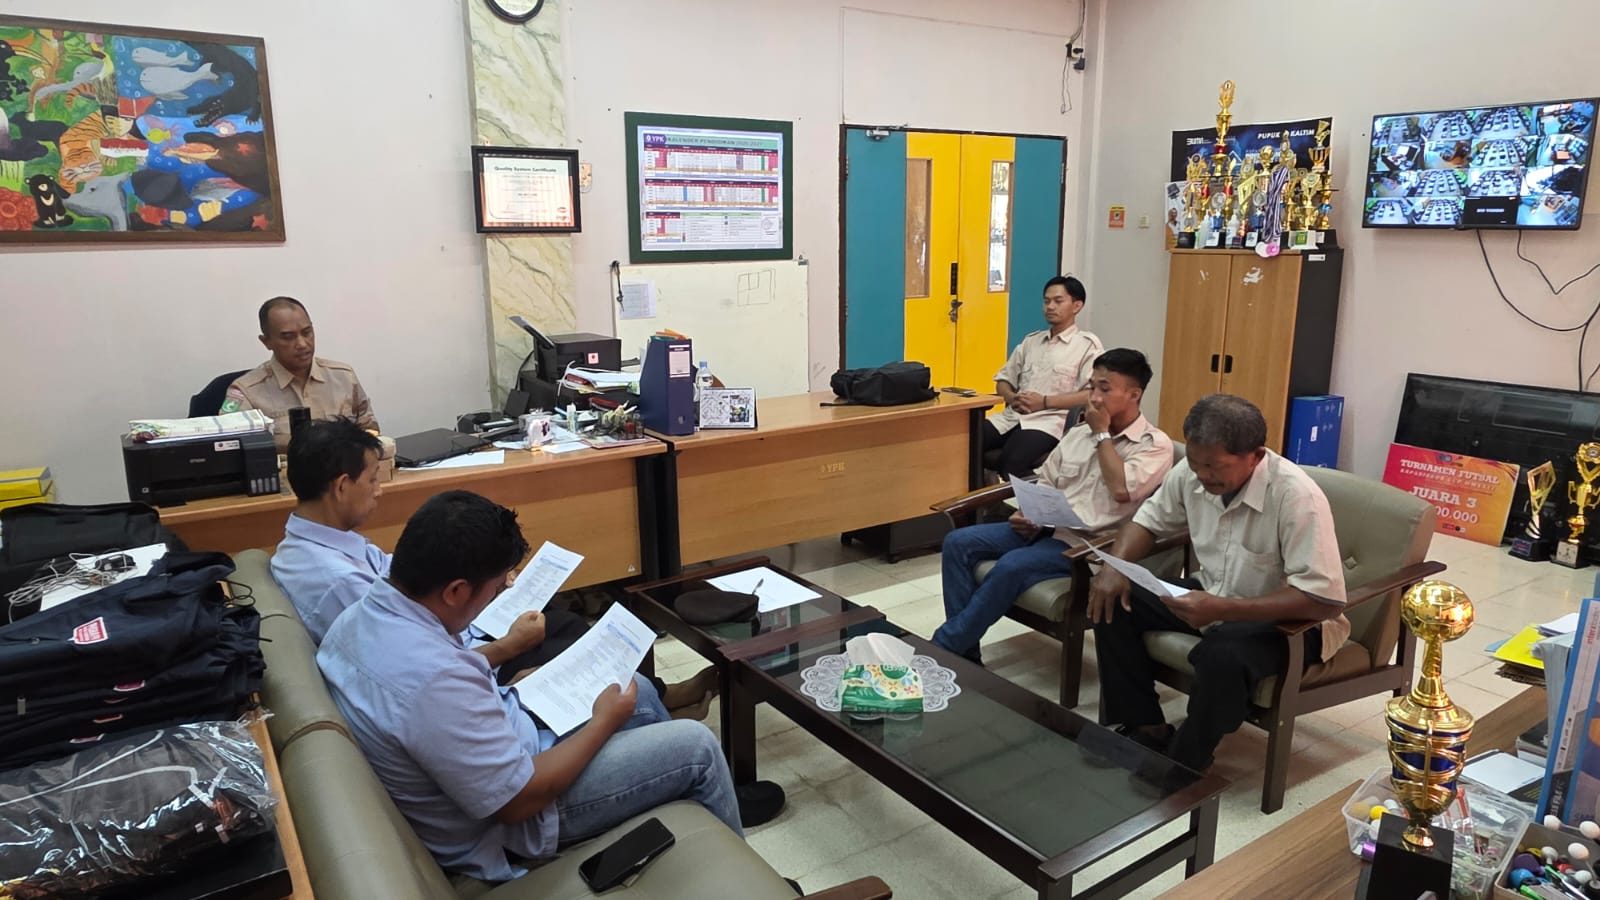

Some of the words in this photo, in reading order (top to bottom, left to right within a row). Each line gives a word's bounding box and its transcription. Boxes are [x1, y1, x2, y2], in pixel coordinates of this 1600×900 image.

[651, 134, 665, 143] YPK
[1290, 129, 1315, 137] KALTIM
[1400, 459, 1457, 476] TURNAMEN
[1458, 470, 1500, 484] FUTSAL
[1409, 486, 1461, 505] JUARA
[1466, 497, 1477, 508] 3
